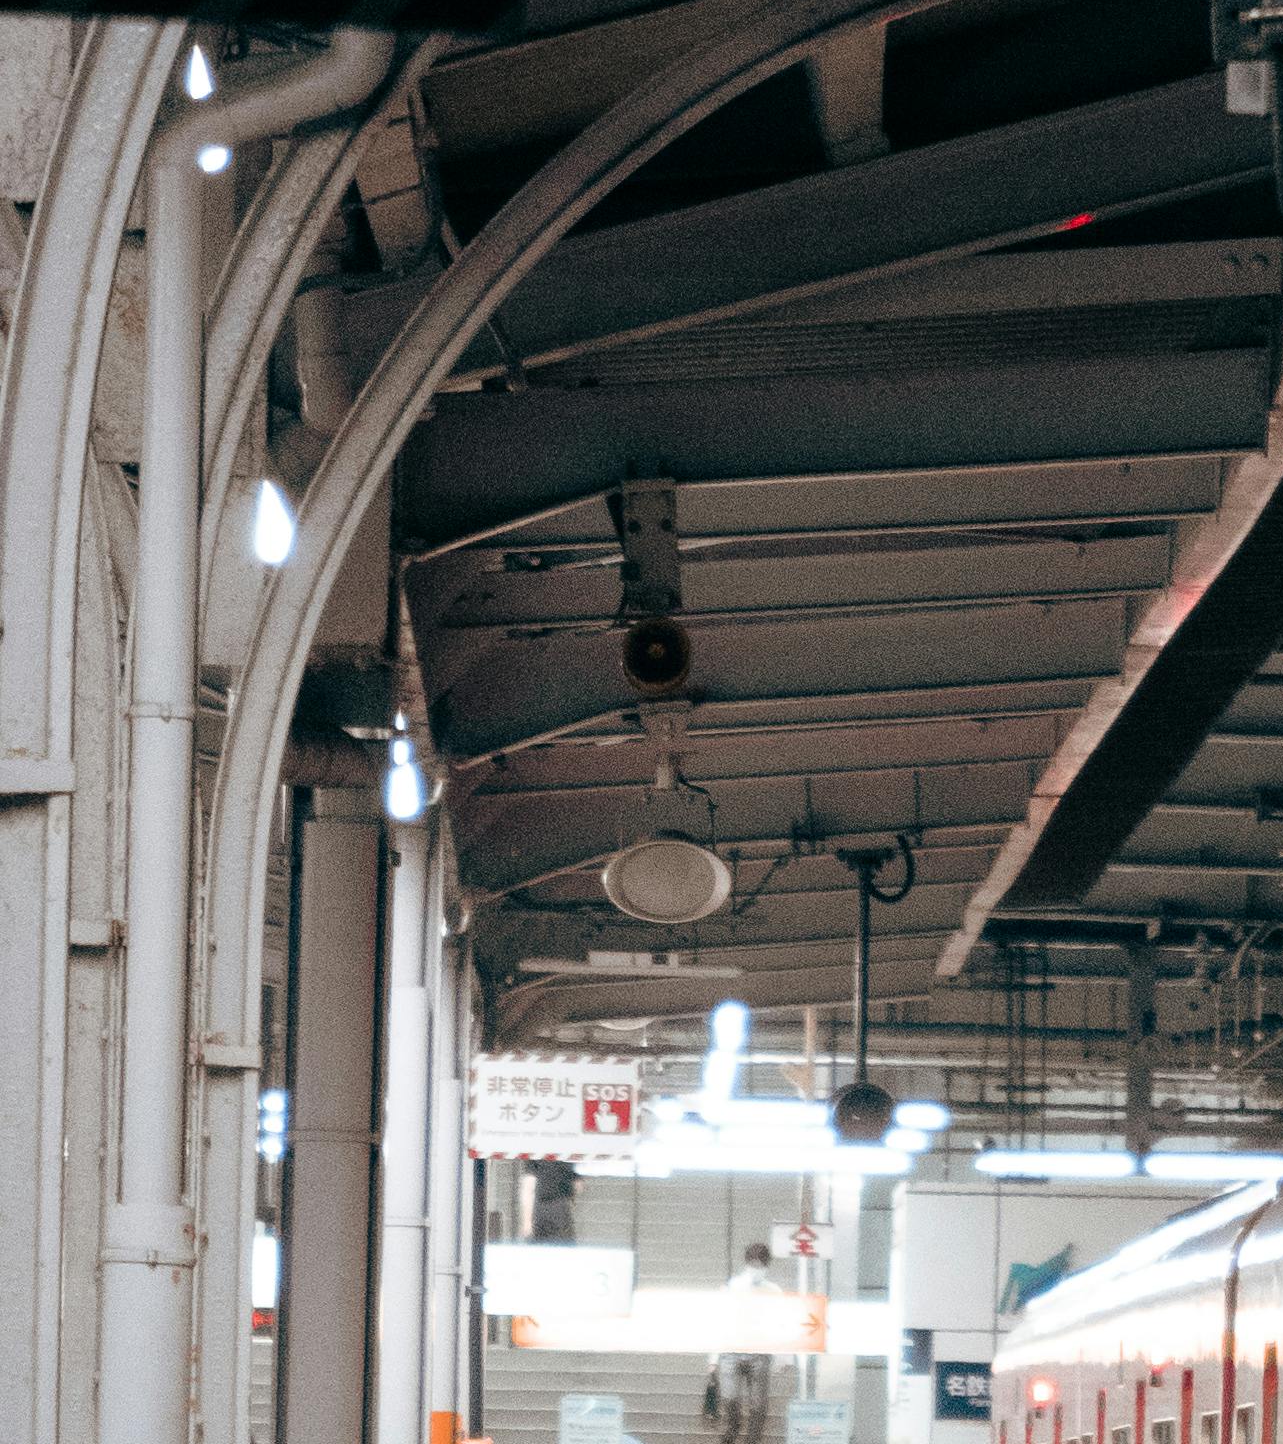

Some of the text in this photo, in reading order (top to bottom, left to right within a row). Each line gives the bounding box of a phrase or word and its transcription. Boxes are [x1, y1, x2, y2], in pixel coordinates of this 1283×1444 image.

[487, 1075, 577, 1098] 非常停止
[586, 1084, 629, 1101] SOS
[498, 1102, 565, 1123] ボタン
